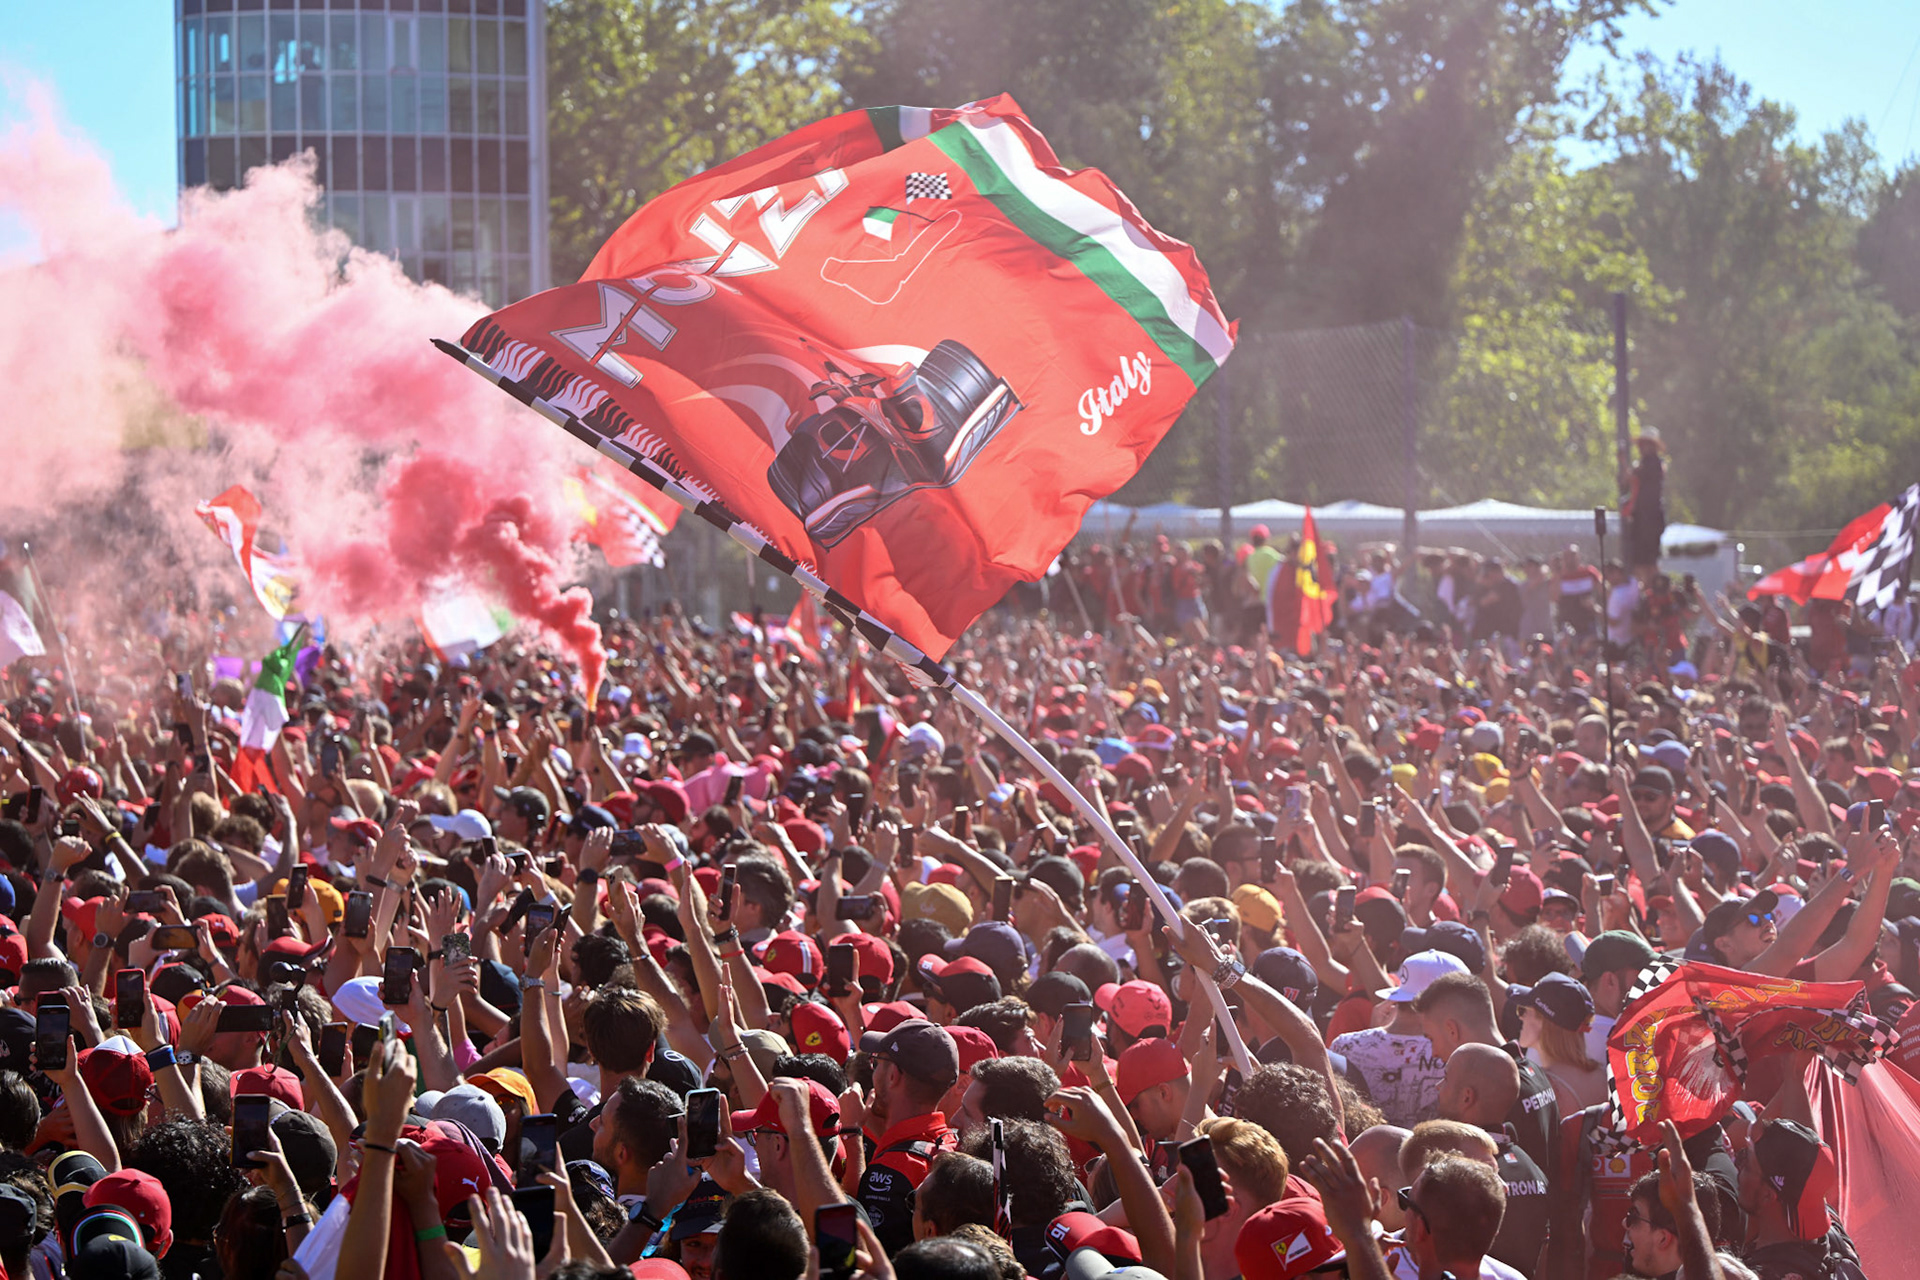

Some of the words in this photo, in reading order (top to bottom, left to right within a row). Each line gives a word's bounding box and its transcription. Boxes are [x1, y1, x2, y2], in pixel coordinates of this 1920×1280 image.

[550, 167, 850, 390] MONZ
[1077, 351, 1152, 436] Italy
[1283, 986, 1300, 1002] 11
[869, 1171, 893, 1185] aws
[1050, 1223, 1071, 1240] 16
